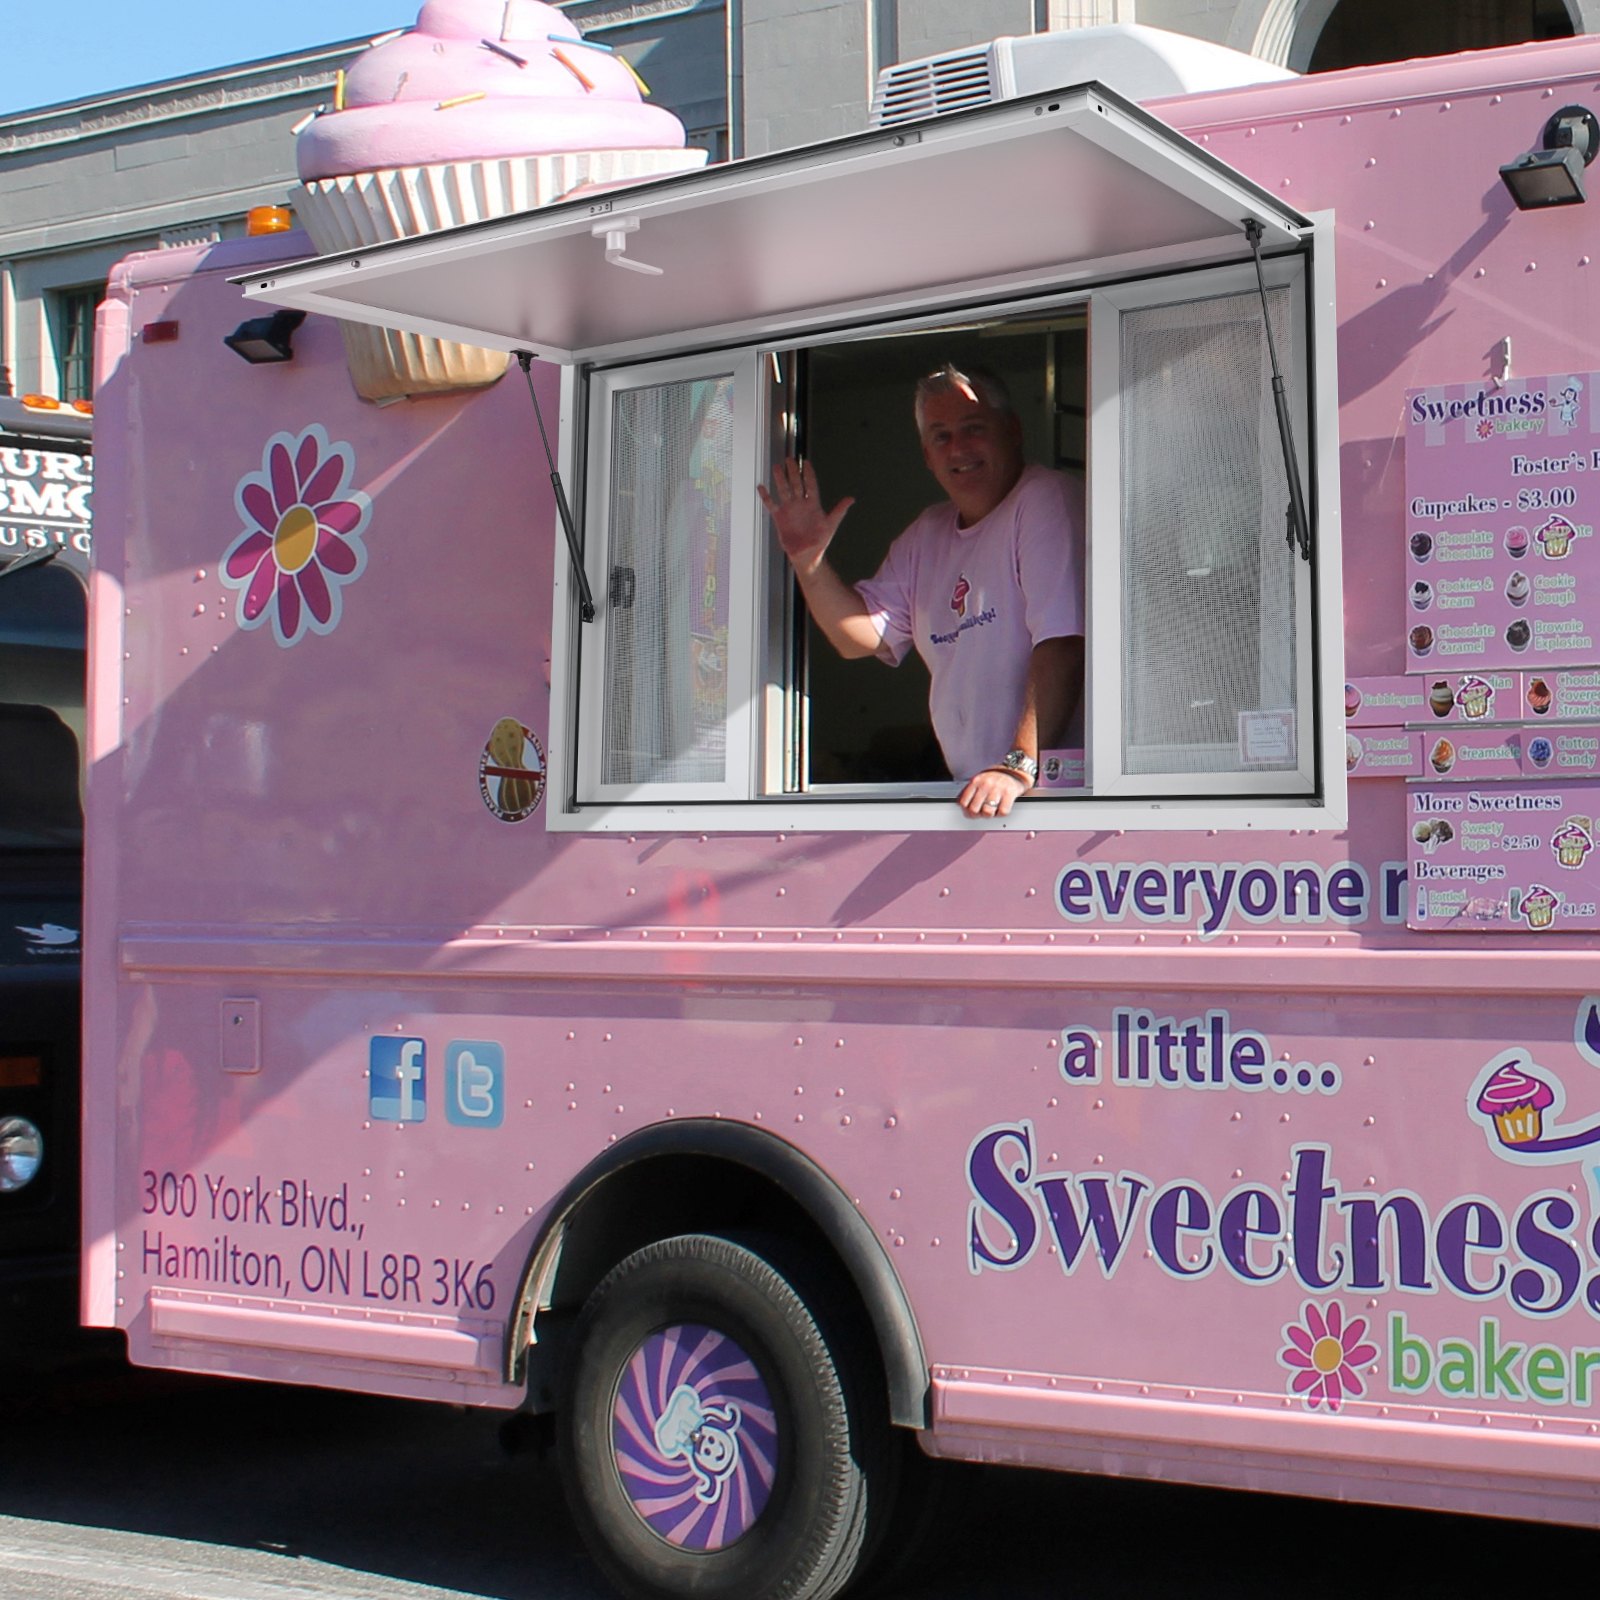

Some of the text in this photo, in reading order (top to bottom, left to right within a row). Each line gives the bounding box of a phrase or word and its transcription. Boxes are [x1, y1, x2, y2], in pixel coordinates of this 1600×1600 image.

[1412, 391, 1545, 423] Sweetness
[1495, 418, 1544, 435] bakery
[1513, 453, 1585, 475] Foster's
[1412, 496, 1497, 520] Cupcakes
[1518, 488, 1575, 511] $3.00
[1436, 531, 1494, 546] Chocolate
[1436, 547, 1494, 562] Chocolate
[1534, 574, 1576, 590] Cookie
[1437, 595, 1475, 609] Cream
[1437, 623, 1495, 639] Chocolate
[1535, 620, 1584, 635] Brownie
[1437, 639, 1485, 655] Caramel
[1556, 736, 1599, 751] Cotton
[1557, 751, 1597, 768] Candy
[1415, 792, 1562, 811] More Sweetness
[1502, 836, 1540, 851] $2.50
[1415, 861, 1505, 882] Beverages
[1059, 866, 1365, 935] everyone
[1562, 903, 1595, 917] $1.25
[1064, 1031, 1096, 1079] a
[142, 1170, 365, 1241] 300 York Blvd.,
[142, 1229, 496, 1311] Hamilton, ON L8R 3K6
